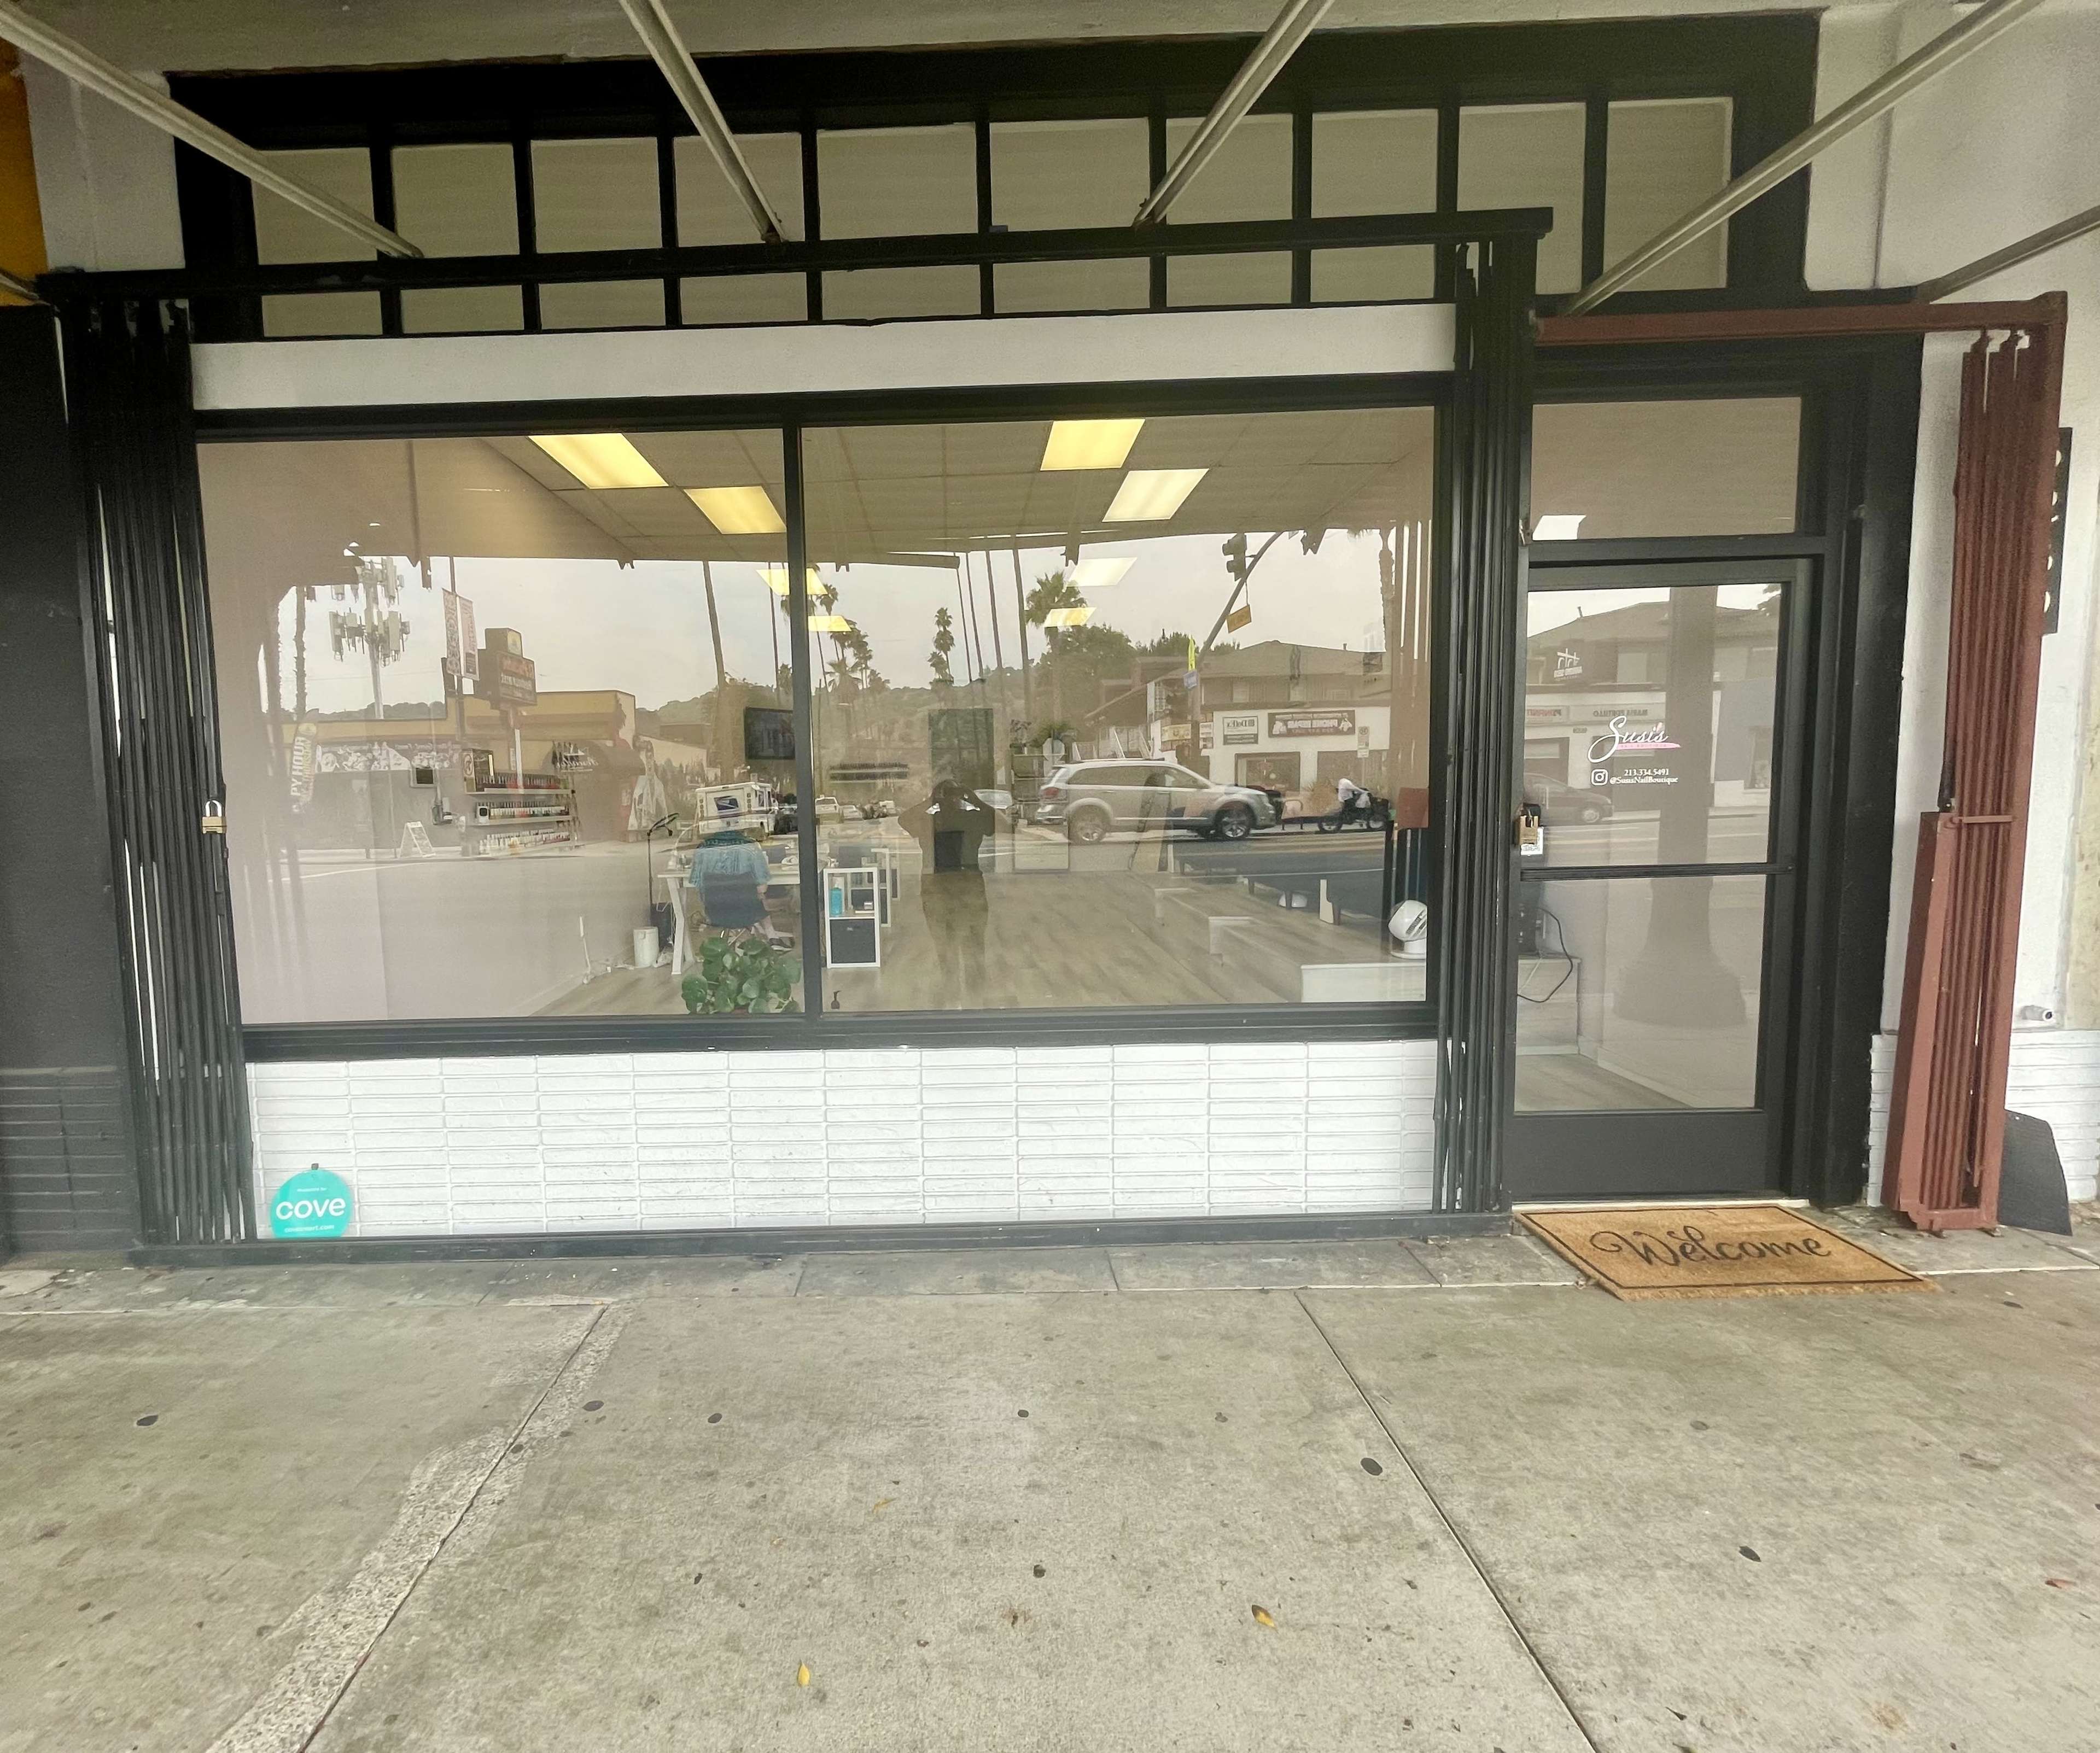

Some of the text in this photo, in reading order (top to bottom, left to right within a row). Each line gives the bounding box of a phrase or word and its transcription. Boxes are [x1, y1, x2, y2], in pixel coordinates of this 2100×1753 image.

[292, 736, 306, 776] HOUR
[1588, 715, 1669, 763] Susi's
[1624, 768, 1669, 776] 213.334.5491
[276, 1197, 346, 1220] cove
[1589, 1225, 1831, 1267] Welcome
